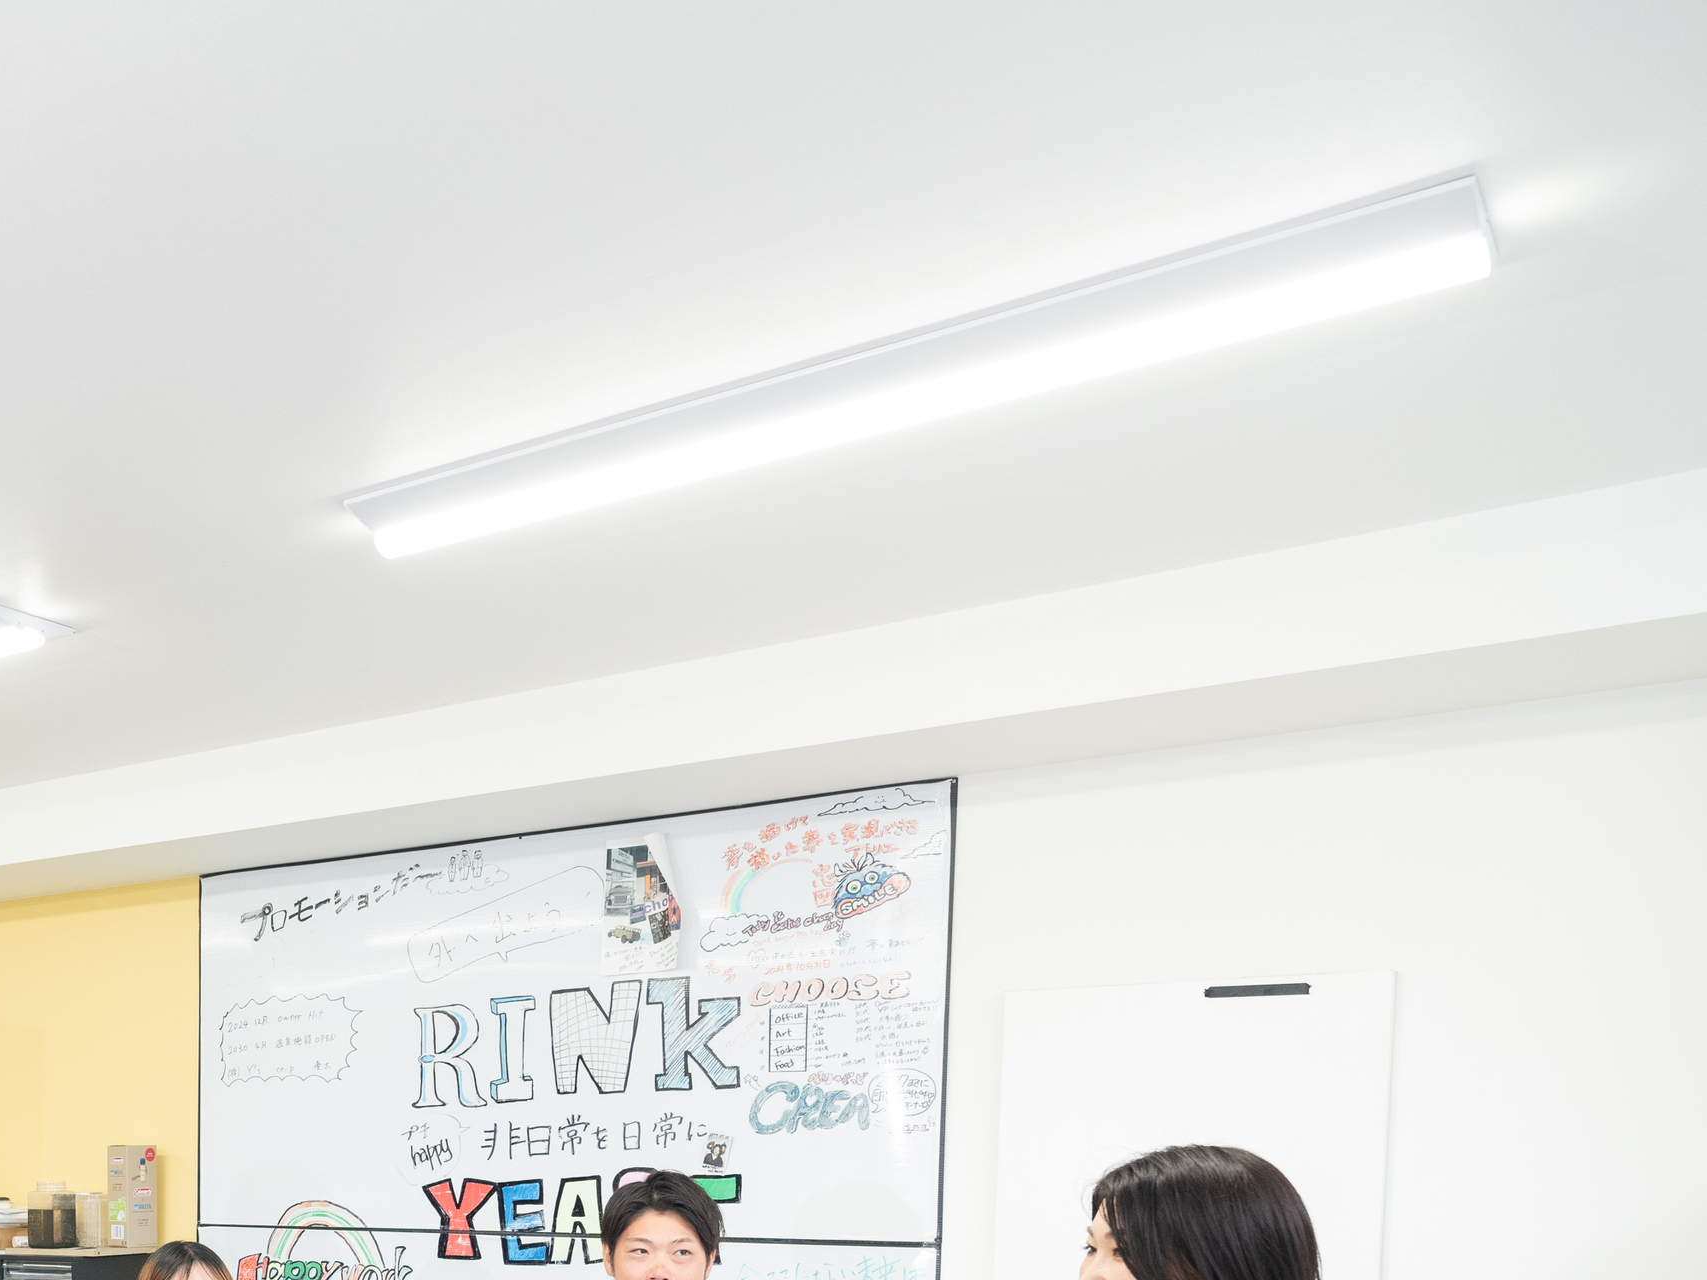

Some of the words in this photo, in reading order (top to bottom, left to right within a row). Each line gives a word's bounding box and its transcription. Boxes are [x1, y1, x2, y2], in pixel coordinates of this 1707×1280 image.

[840, 883, 899, 916] SMILE
[747, 970, 912, 1007] CHOOSE
[412, 976, 742, 1109] RINK
[775, 1029, 793, 1039] Art
[481, 1111, 707, 1161] 非日常を日常に
[410, 1137, 453, 1171] happy
